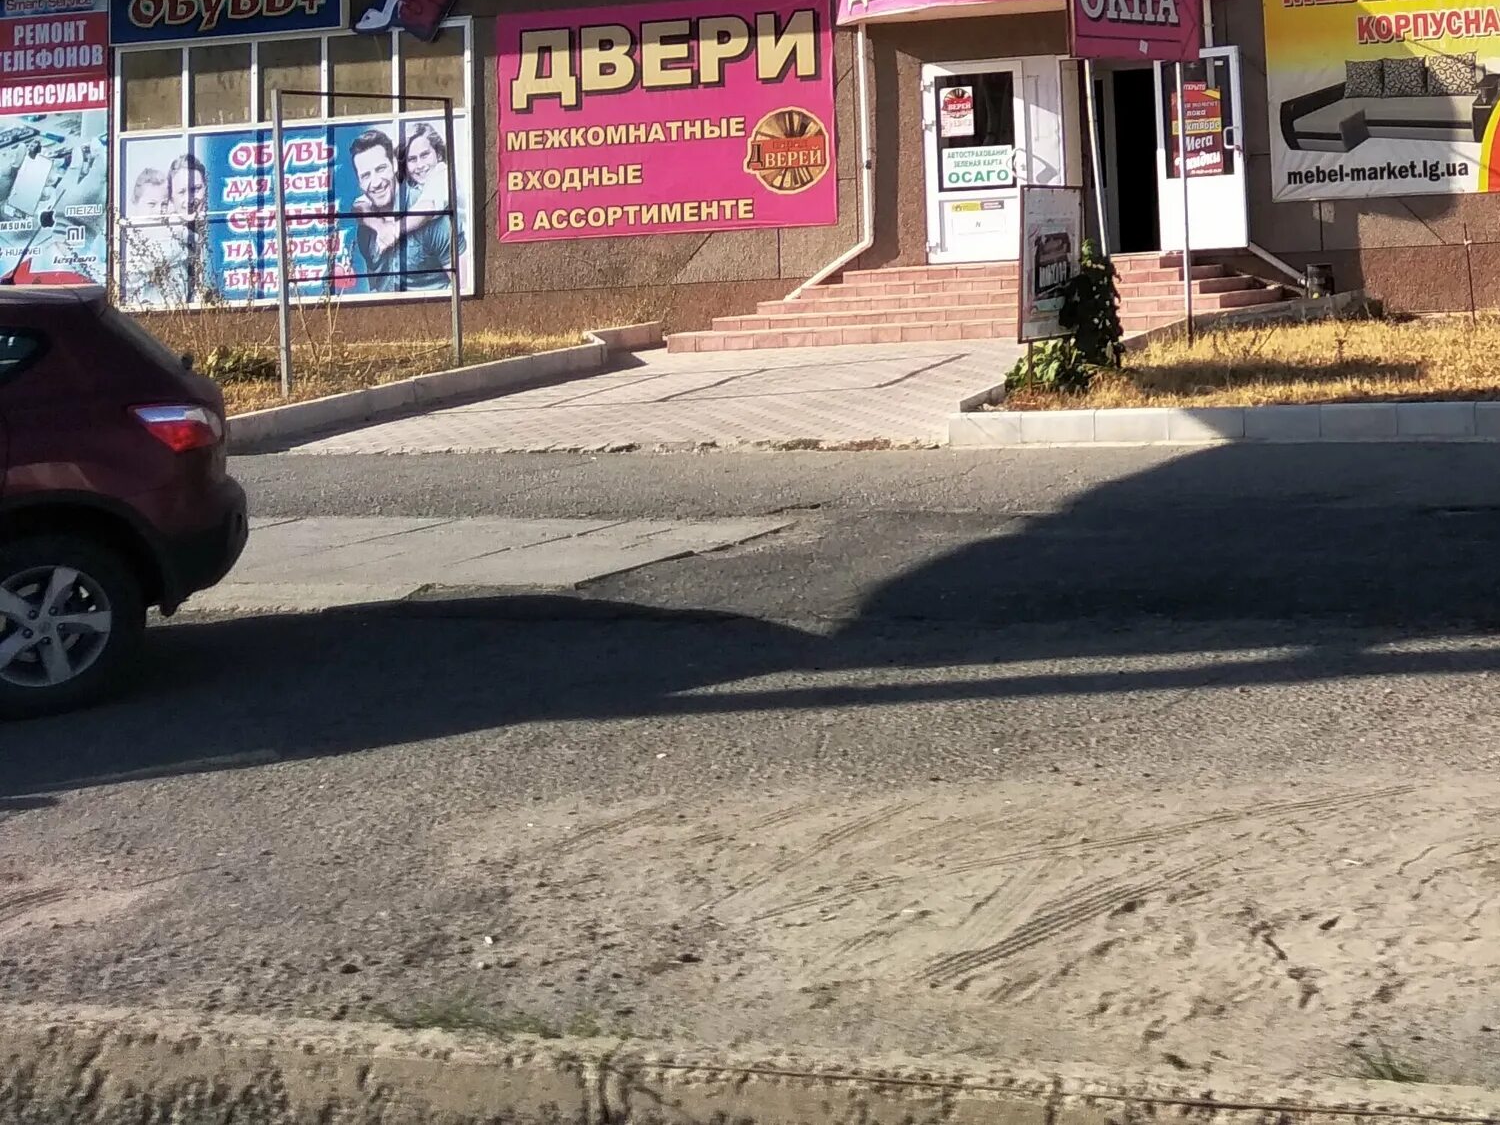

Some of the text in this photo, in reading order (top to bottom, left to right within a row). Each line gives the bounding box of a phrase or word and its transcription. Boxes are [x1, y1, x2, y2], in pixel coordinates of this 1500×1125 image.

[14, 20, 87, 46] РЕМОНТ
[0, 44, 104, 72] ЕЛЕФОНОВ
[511, 8, 822, 111] ДВЕРИ
[0, 80, 106, 108] КСЕССУАРЫ
[506, 116, 746, 151] МЕЖКОМНАТНЫЕ
[748, 143, 822, 170] ДВЕРЕЙ
[507, 163, 643, 192] ВХОДНЫЕ
[948, 169, 1009, 184] ОСАГО
[1287, 160, 1469, 185] mebel-market.lg.ua
[66, 205, 101, 216] MEIZU
[507, 198, 755, 232] В АССОРТИМЕНТЕ
[227, 267, 323, 289] БЮДЕТ
